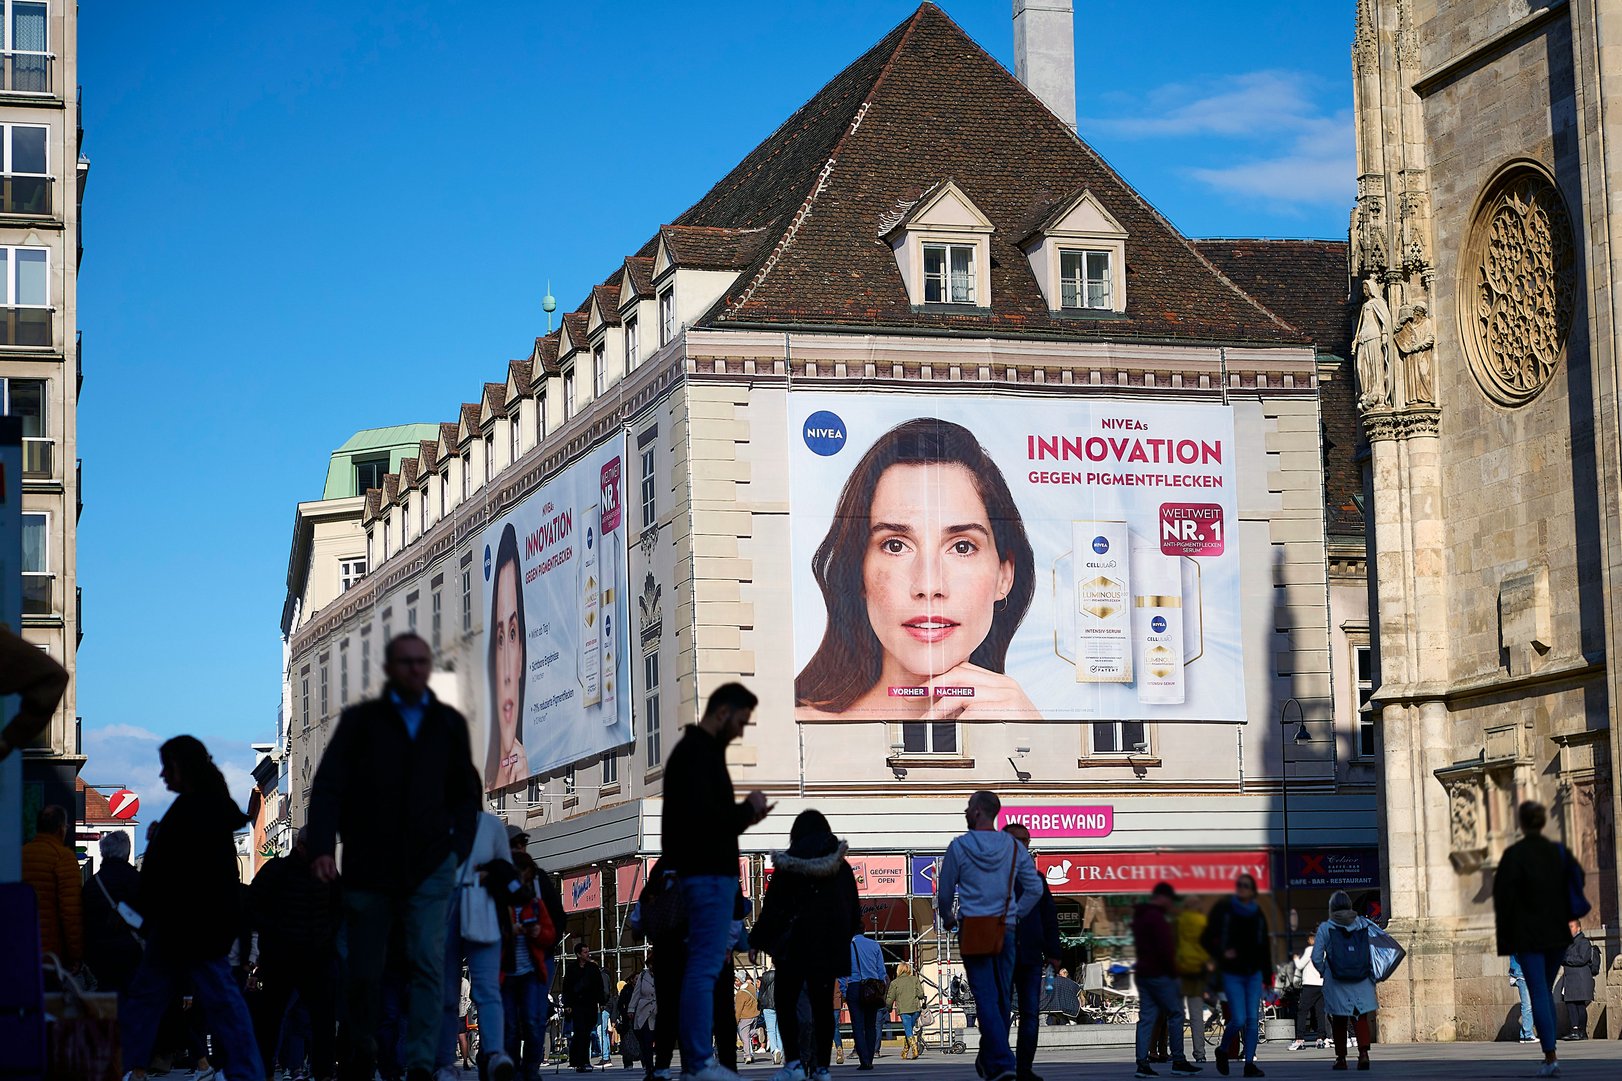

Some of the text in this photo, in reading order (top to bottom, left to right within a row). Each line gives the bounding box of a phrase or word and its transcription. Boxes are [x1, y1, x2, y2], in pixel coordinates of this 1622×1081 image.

[1102, 418, 1148, 430] NIVEAs
[807, 428, 843, 438] NIVEA
[1028, 435, 1222, 465] INNOVATION
[1028, 471, 1223, 488] GEGEN PIGMENTFLECKEN
[1162, 508, 1220, 518] WELTWEIT
[526, 508, 572, 562] INNOVATION
[1163, 519, 1221, 541] NR. 1
[1005, 814, 1106, 830] WERBEWAND
